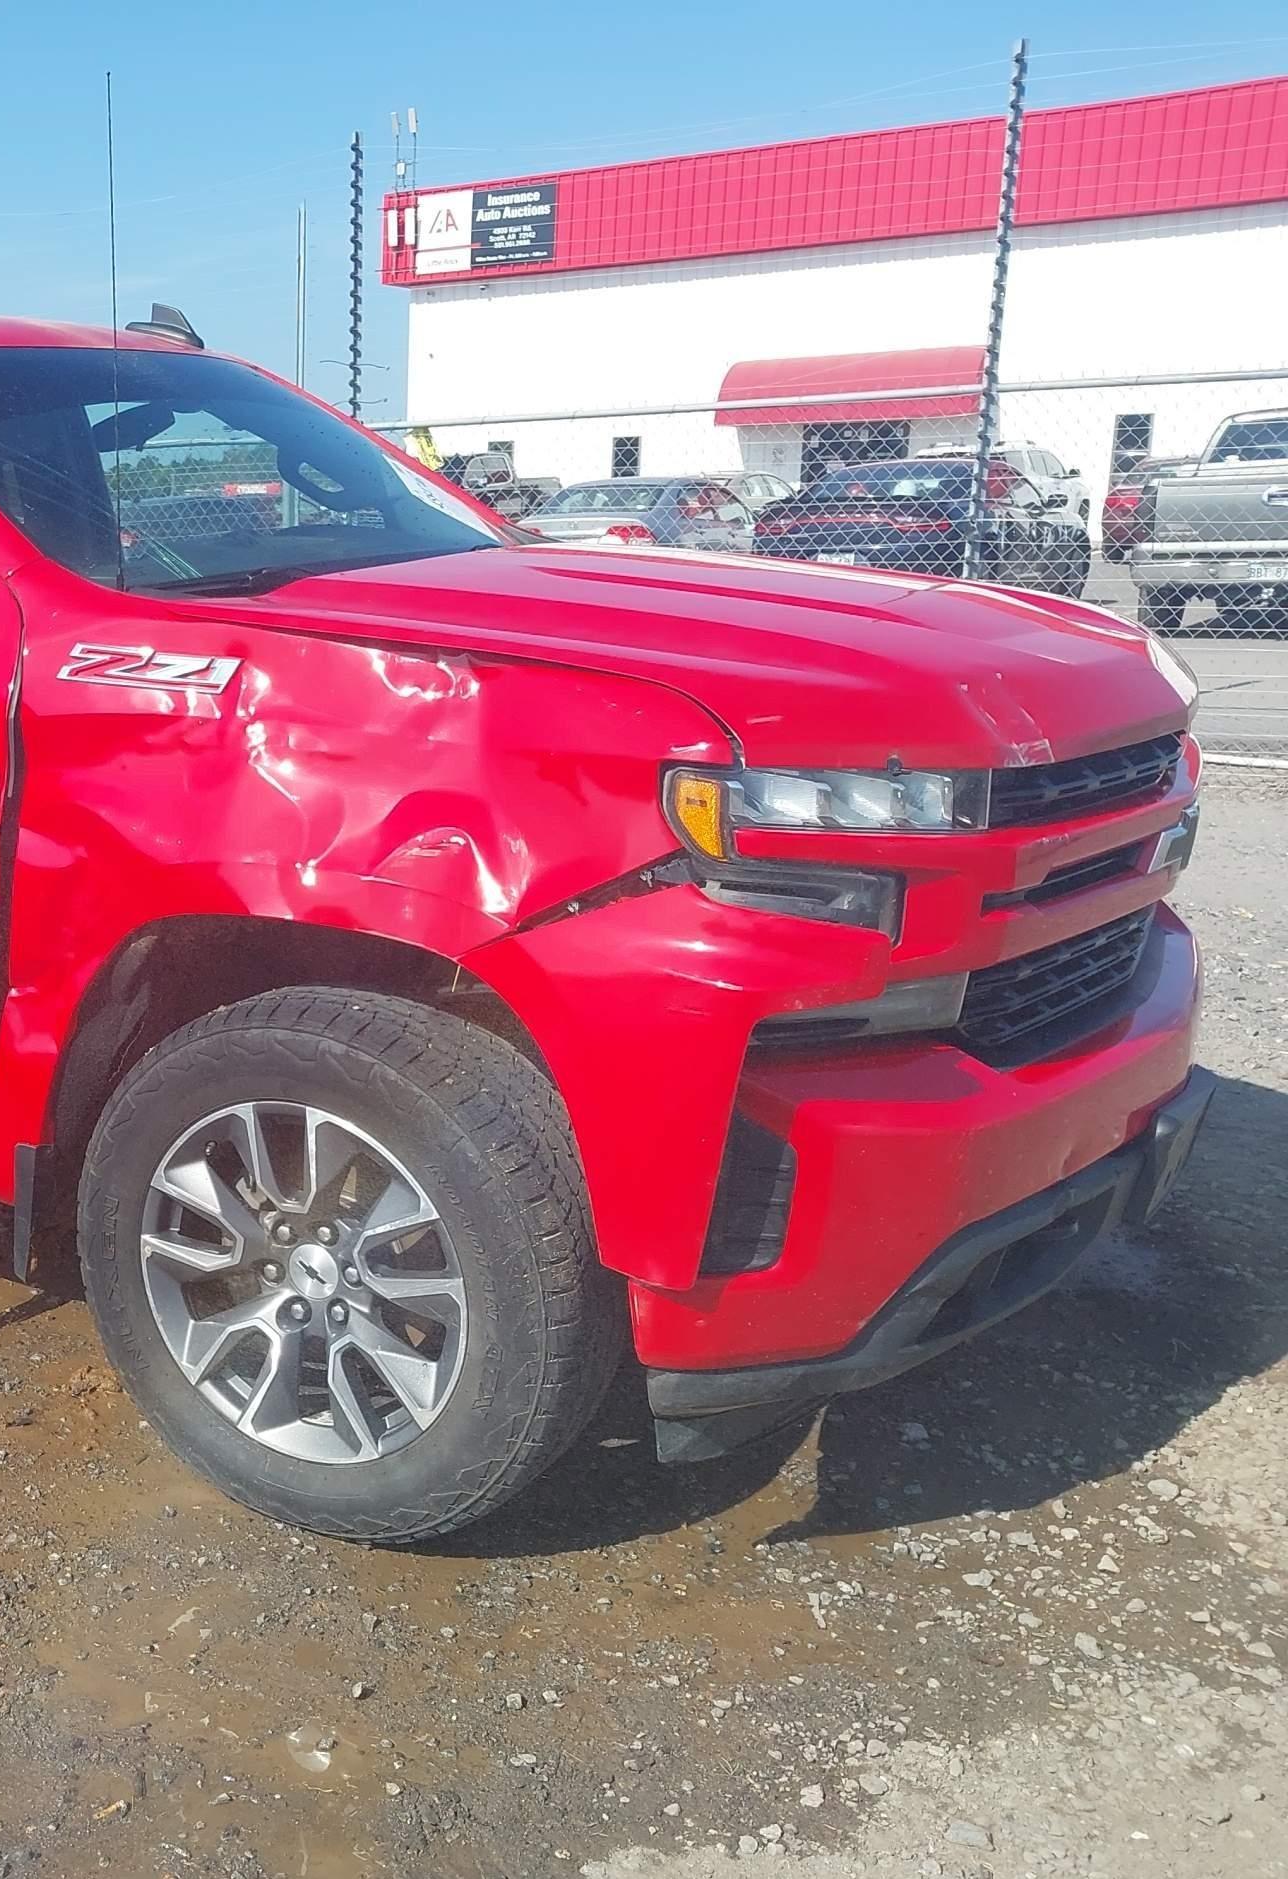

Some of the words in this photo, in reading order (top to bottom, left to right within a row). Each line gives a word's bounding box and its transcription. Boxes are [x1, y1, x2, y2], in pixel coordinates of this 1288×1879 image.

[487, 191, 541, 207] Insurance
[476, 209, 501, 223] Auto
[502, 204, 551, 220] Auctions
[56, 642, 246, 695] Z71
